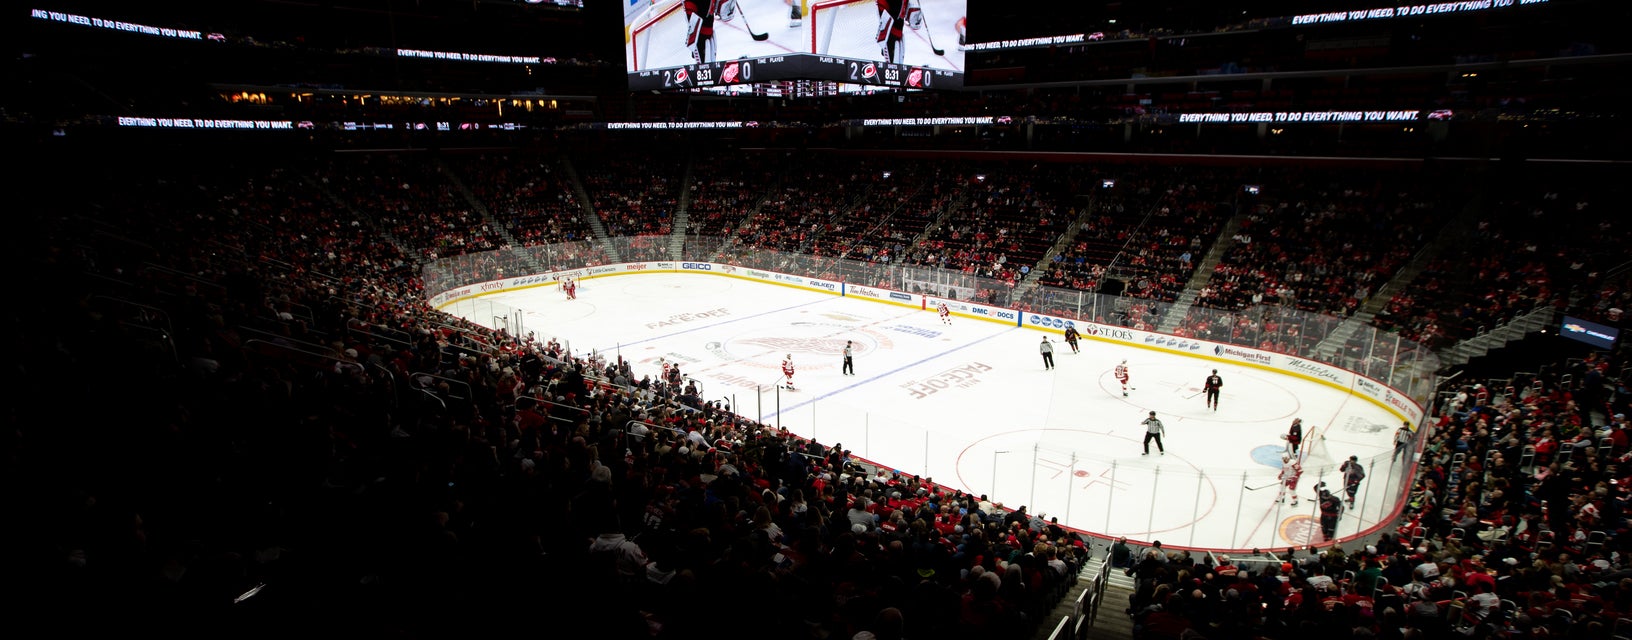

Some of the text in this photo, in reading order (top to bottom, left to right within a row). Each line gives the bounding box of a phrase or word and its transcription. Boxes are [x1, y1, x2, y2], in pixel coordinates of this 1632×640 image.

[1292, 12, 1347, 24] EVERYTHING
[1349, 10, 1368, 20] YOU
[1397, 6, 1410, 16] TO
[1409, 5, 1425, 15] DO
[1426, 0, 1492, 13] EVERYTHING
[49, 11, 66, 21] YOU
[92, 18, 103, 27] TO
[104, 20, 114, 28] DO
[116, 22, 159, 35] EVERYTHING
[160, 28, 176, 37] YOU
[178, 30, 202, 39] WANT.
[1018, 37, 1052, 46] EVERYTHING
[1066, 34, 1084, 42] WANT.
[398, 49, 433, 57] EVERYTHING
[696, 69, 712, 81] 8:31
[742, 62, 751, 80] 0
[850, 62, 858, 80] 2
[885, 69, 899, 80] 8:31
[664, 70, 671, 87] 2
[924, 70, 931, 87] 0
[118, 117, 156, 126] EVERYTHING
[157, 119, 173, 127] YOU
[195, 119, 205, 127] TO
[215, 120, 255, 128] EVERYTHING
[1179, 113, 1230, 122] EVERYTHING
[1231, 113, 1249, 121] YOU
[1275, 112, 1287, 121] TO
[1288, 112, 1301, 121] DO
[1302, 112, 1362, 121] EVERYTHING
[1365, 111, 1385, 120] YOU
[1386, 111, 1419, 120] WANT.
[626, 263, 647, 271] meijer
[682, 262, 711, 271] GEICO
[480, 281, 504, 292] xfinity
[849, 285, 860, 295] Tim
[972, 307, 988, 315] DMC
[997, 311, 1014, 320] DOCS
[1098, 327, 1133, 340] ST. JOE'S
[1225, 348, 1271, 362] Michigan First
[909, 361, 993, 400] FACE-OFF
[1391, 397, 1408, 413] BELLE
